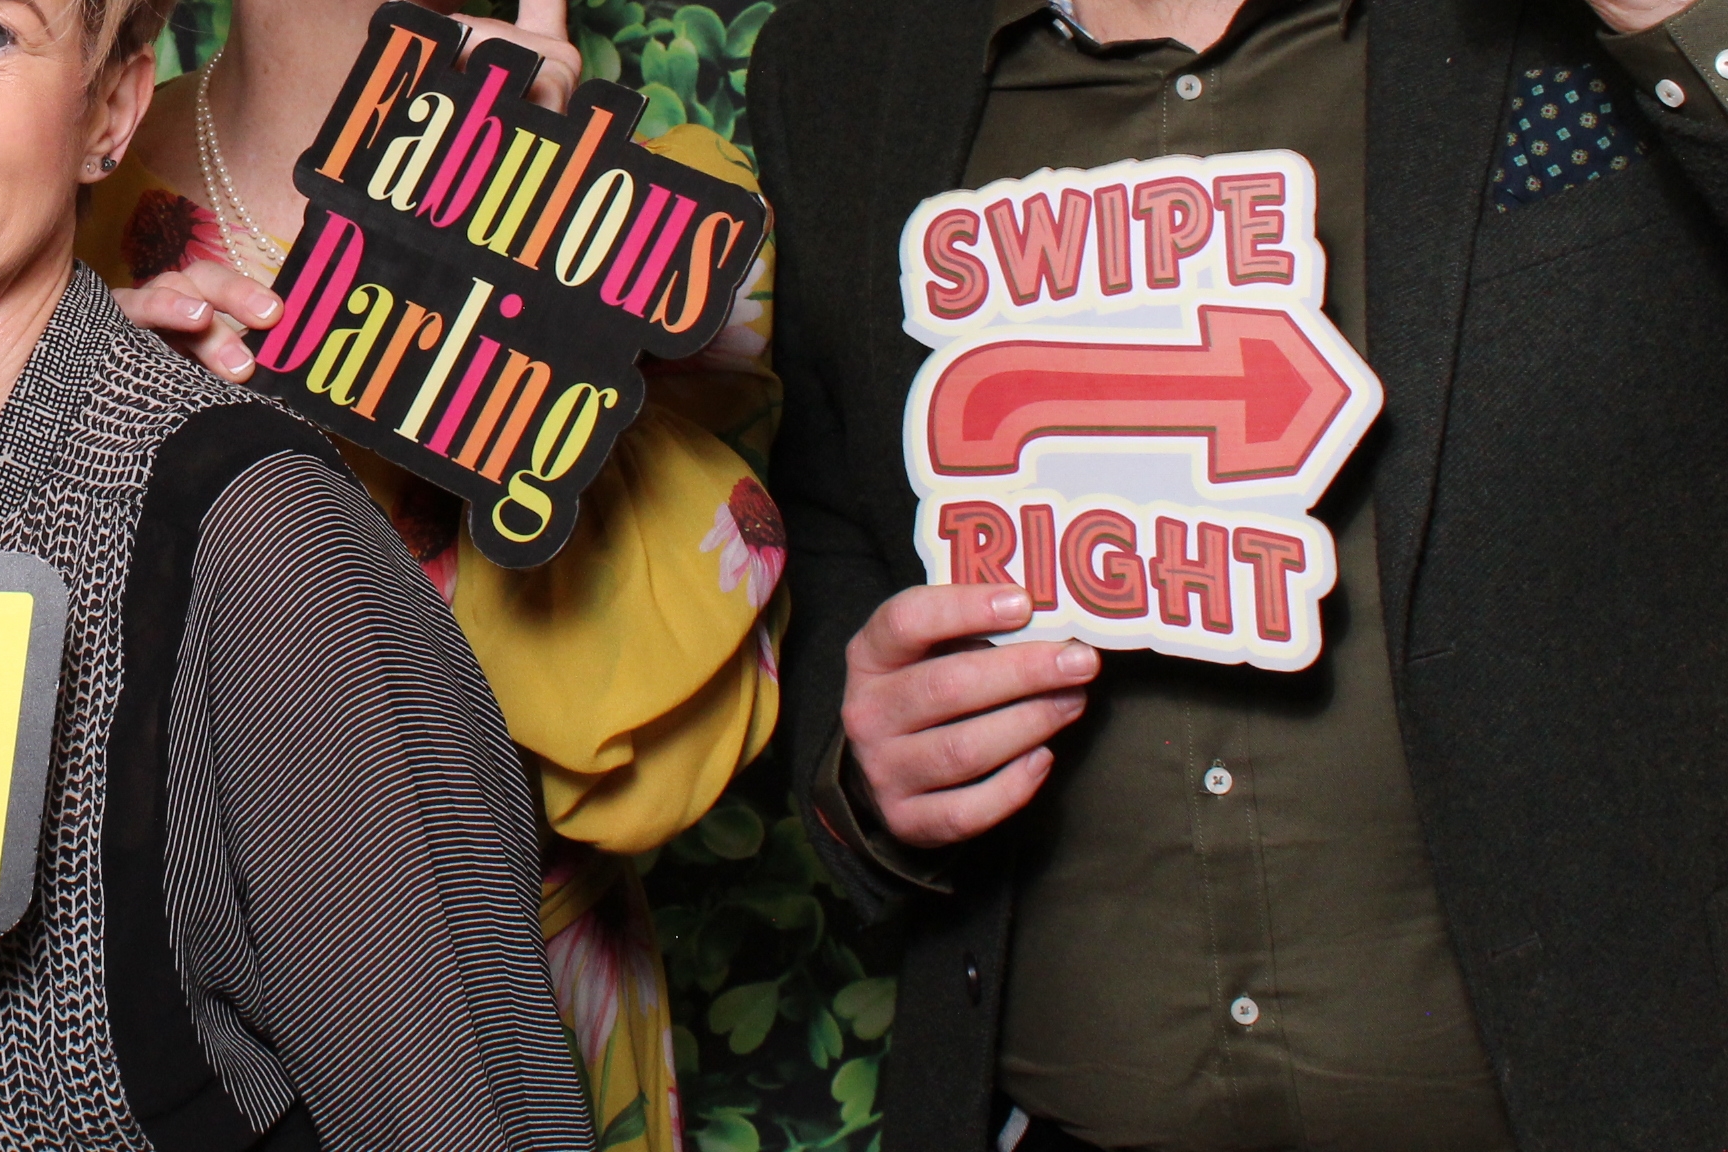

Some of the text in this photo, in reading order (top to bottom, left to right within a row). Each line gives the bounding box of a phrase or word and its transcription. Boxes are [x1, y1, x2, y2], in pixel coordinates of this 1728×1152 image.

[314, 23, 745, 335] Fabulous
[923, 172, 1294, 319] SWIPE
[255, 209, 619, 544] Darling
[937, 500, 1306, 642] RIGHT
